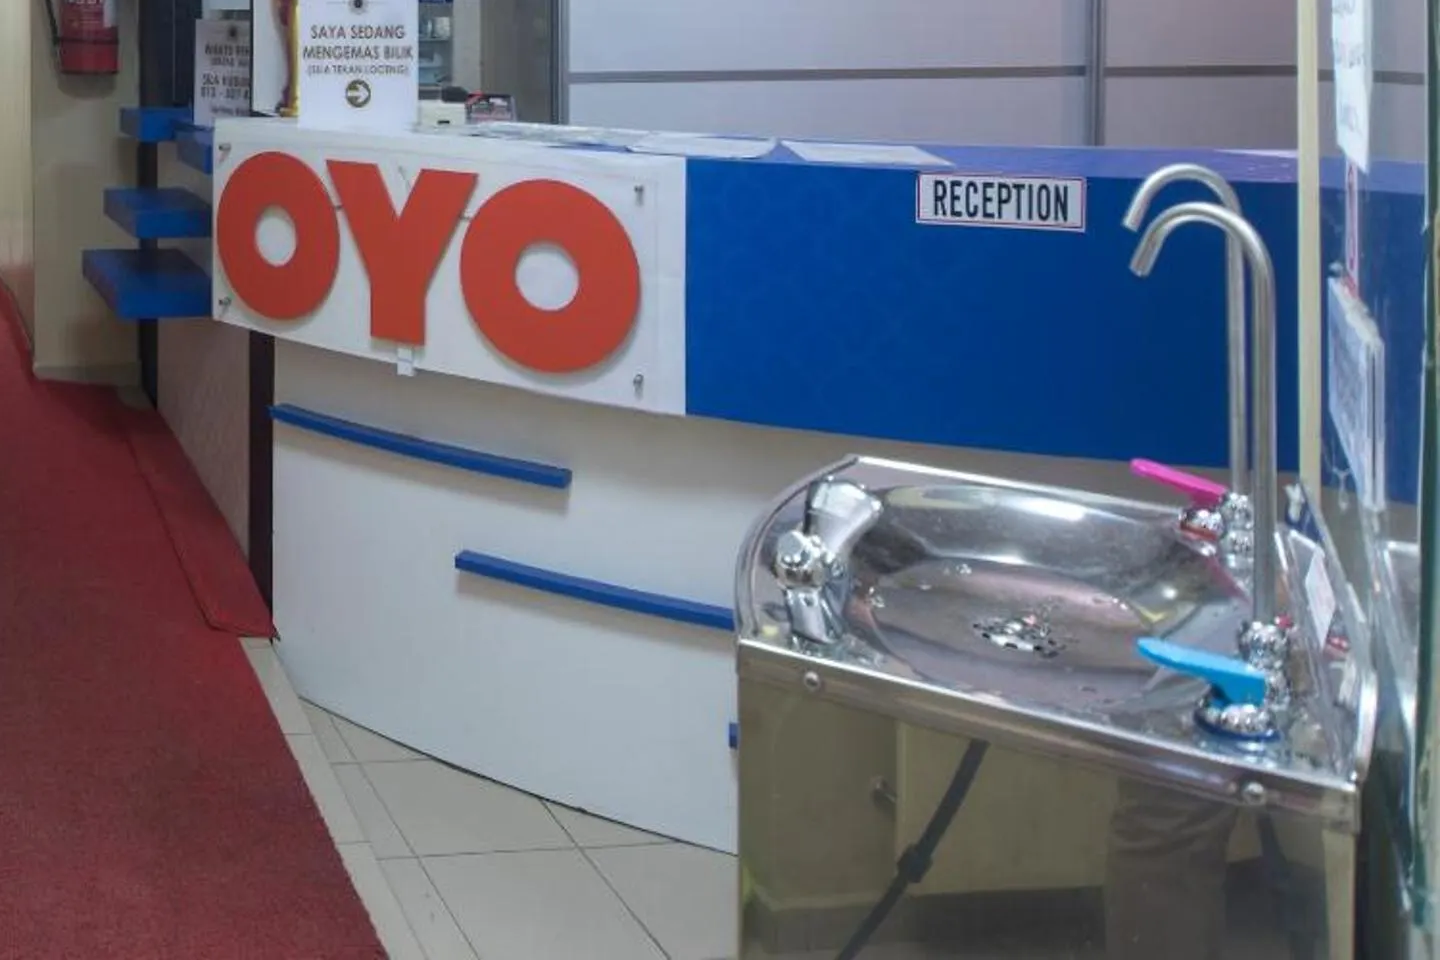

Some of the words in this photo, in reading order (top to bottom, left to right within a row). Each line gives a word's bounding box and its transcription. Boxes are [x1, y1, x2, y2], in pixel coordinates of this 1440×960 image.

[310, 24, 346, 40] SAYA
[350, 24, 406, 40] SEDANG
[303, 44, 380, 60] MENGEMAS
[383, 45, 414, 60] BILIK
[933, 180, 1069, 222] RECEPTION
[216, 151, 640, 373] OYO
